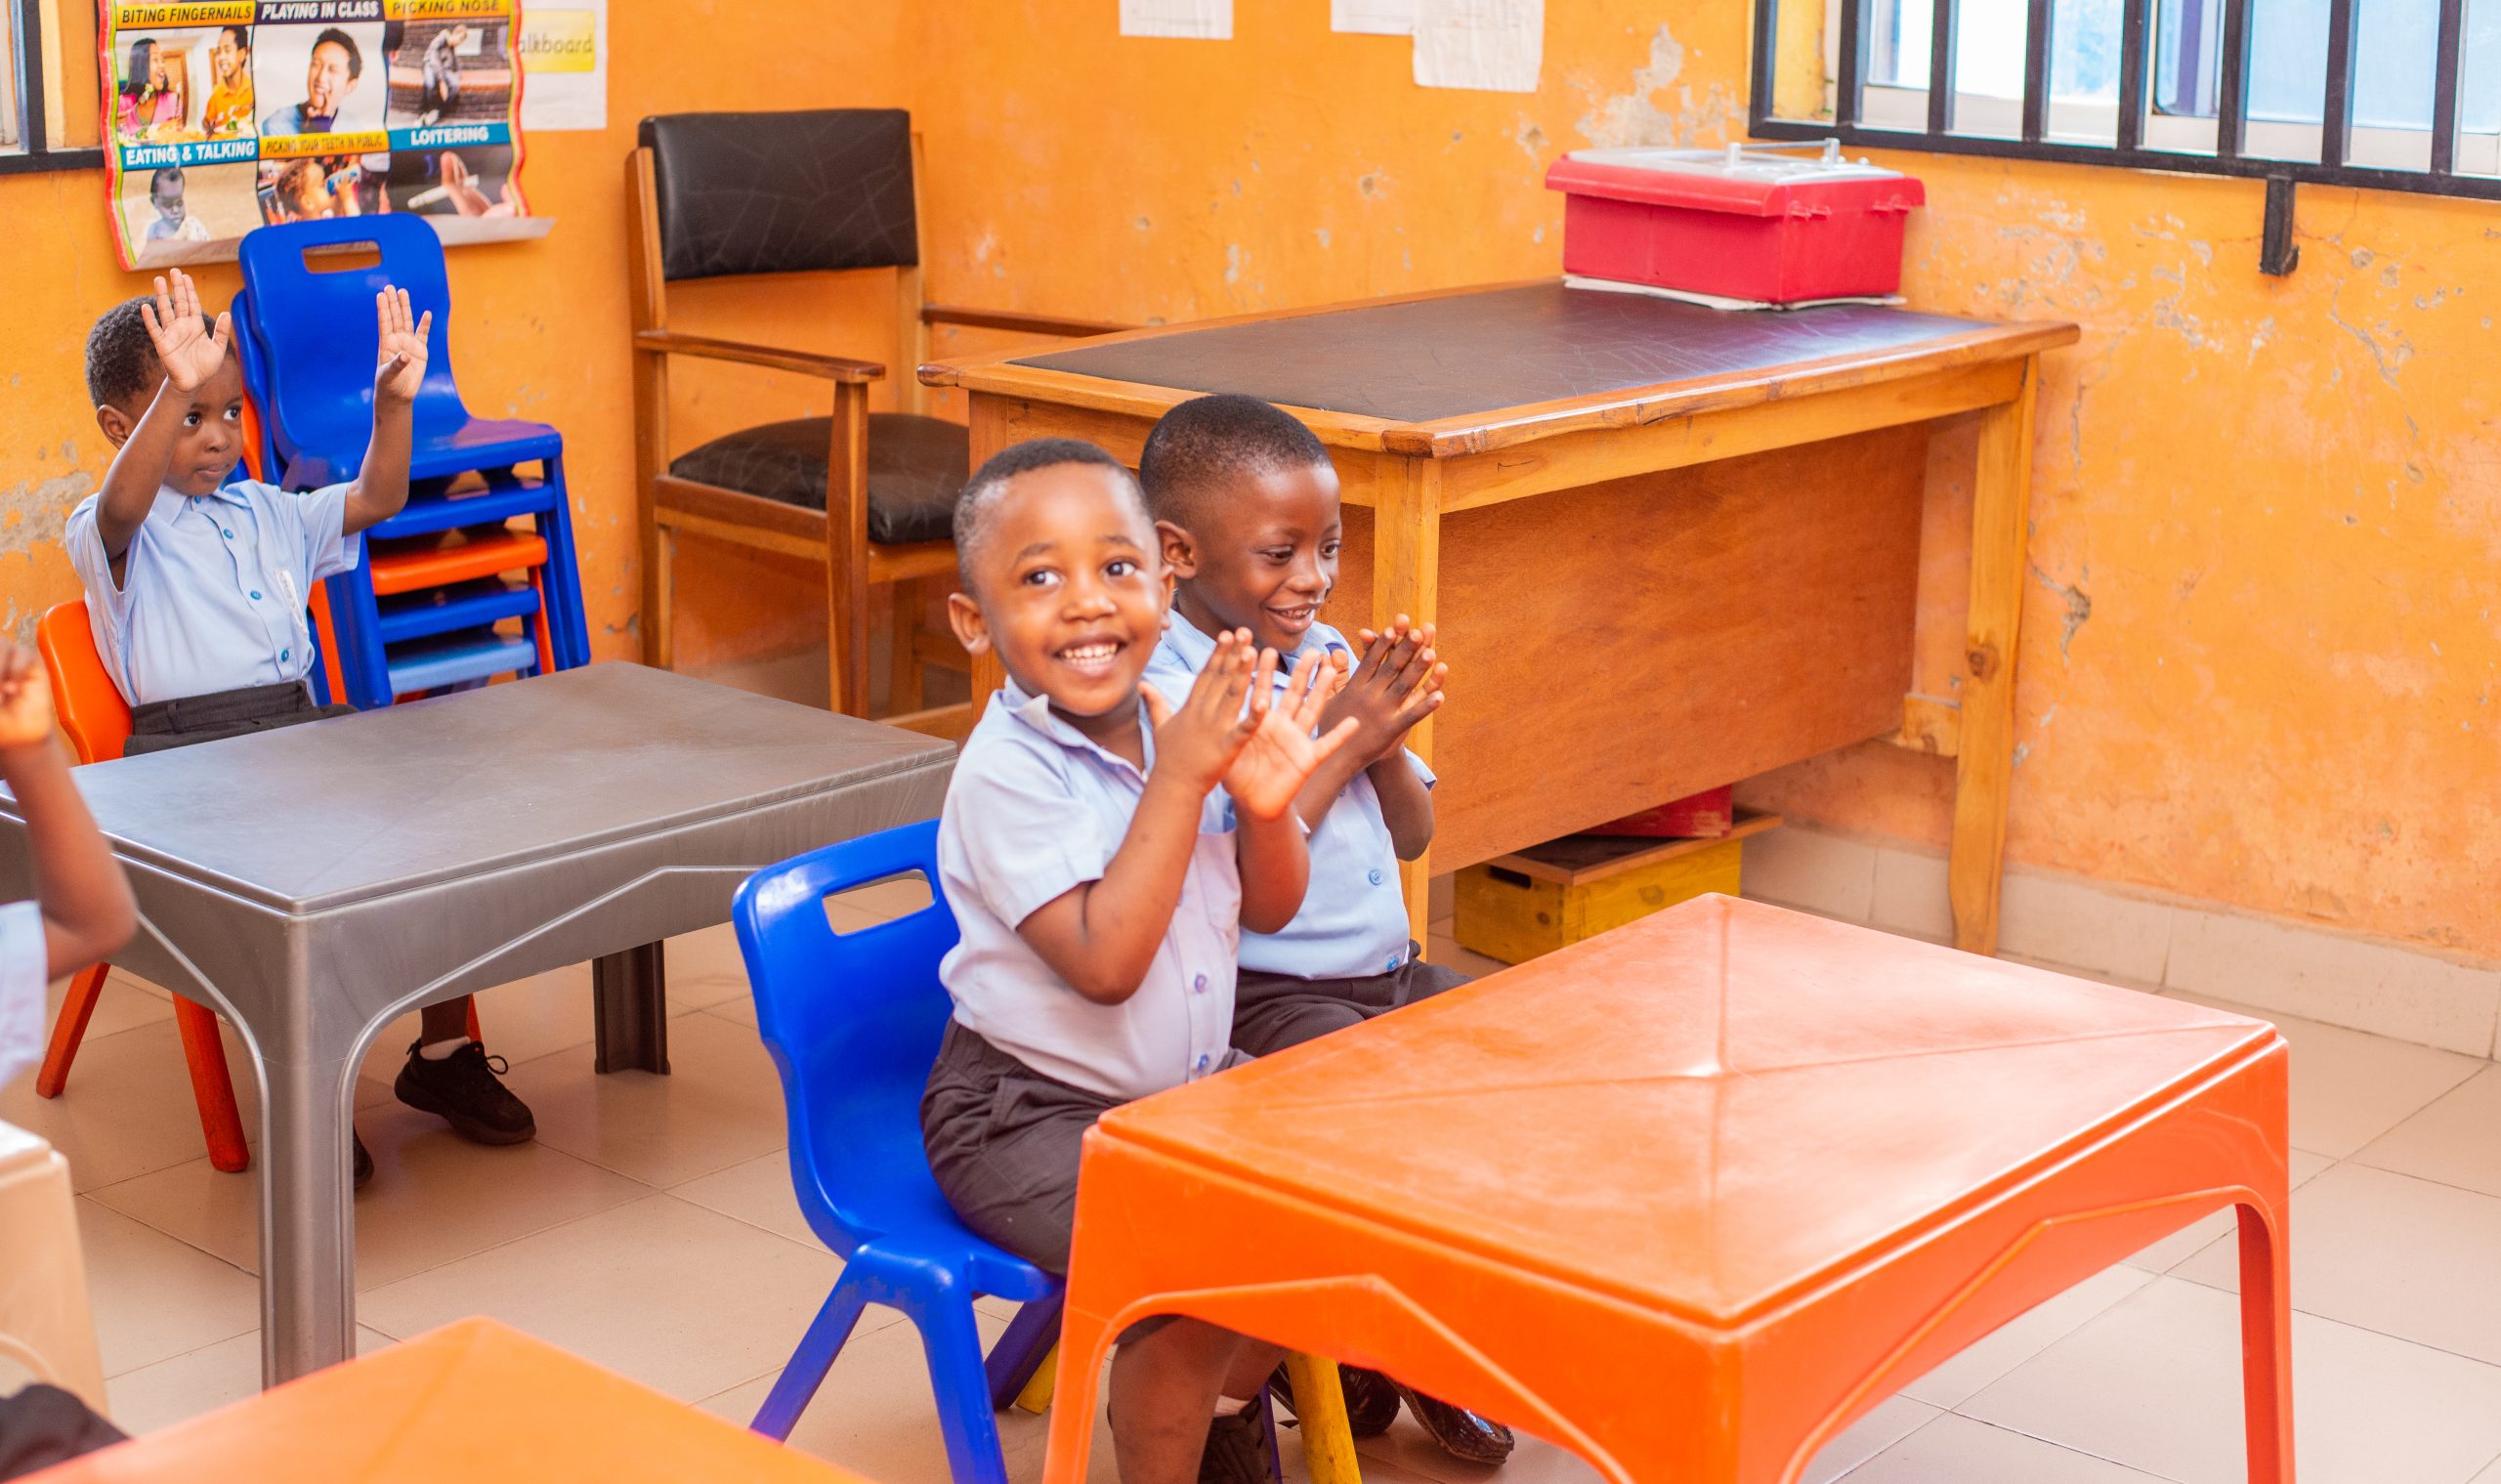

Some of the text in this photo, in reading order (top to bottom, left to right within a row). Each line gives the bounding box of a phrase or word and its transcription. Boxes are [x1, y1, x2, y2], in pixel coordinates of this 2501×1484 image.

[122, 6, 252, 23] BITING FINGERNAILS
[261, 0, 379, 20] PLAYING IN CLASS
[393, 0, 498, 15] PICKING NOSE
[410, 125, 489, 146] LOITERING
[125, 141, 255, 166] EATING & TALKING
